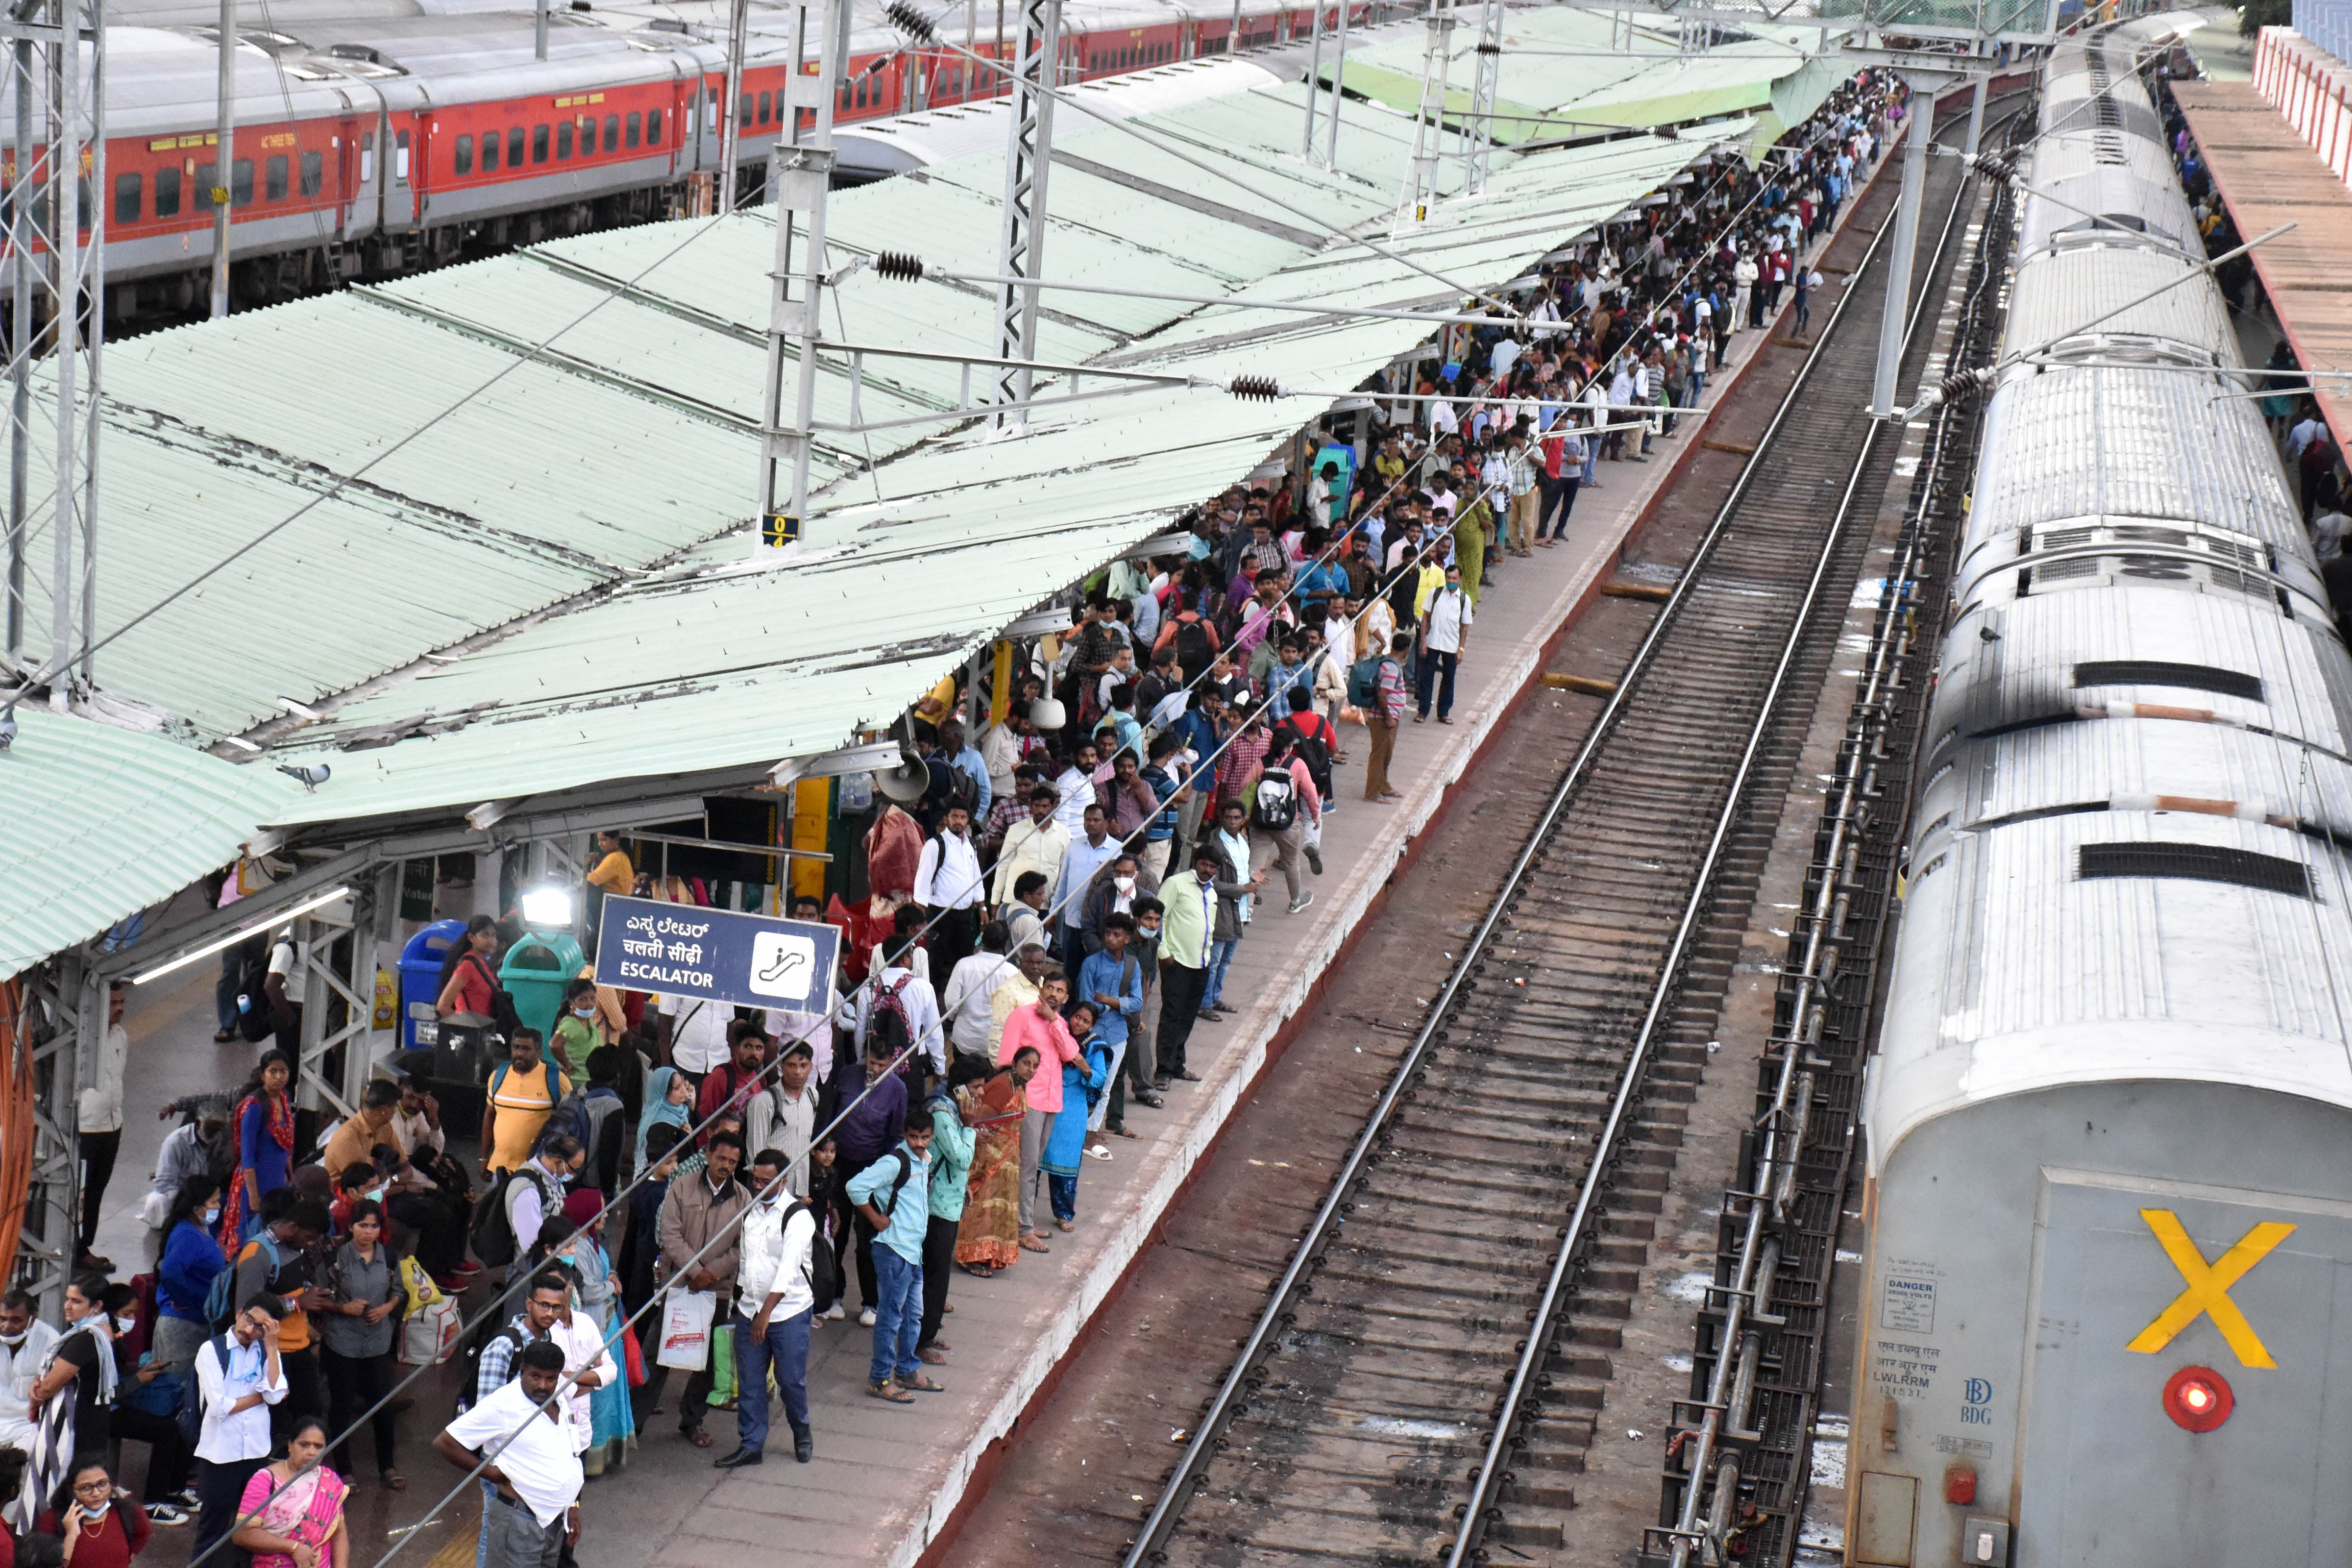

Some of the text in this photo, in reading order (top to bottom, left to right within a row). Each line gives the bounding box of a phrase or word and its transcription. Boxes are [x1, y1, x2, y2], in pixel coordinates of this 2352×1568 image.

[623, 938, 703, 966] चलती सीढ़ी
[620, 961, 713, 988] ESCALATOR
[1889, 1280, 1933, 1292] DANGER
[1873, 1372, 1929, 1389] LWLRRM
[1880, 1386, 1920, 1397] 121531
[1960, 1406, 1992, 1425] BDG
